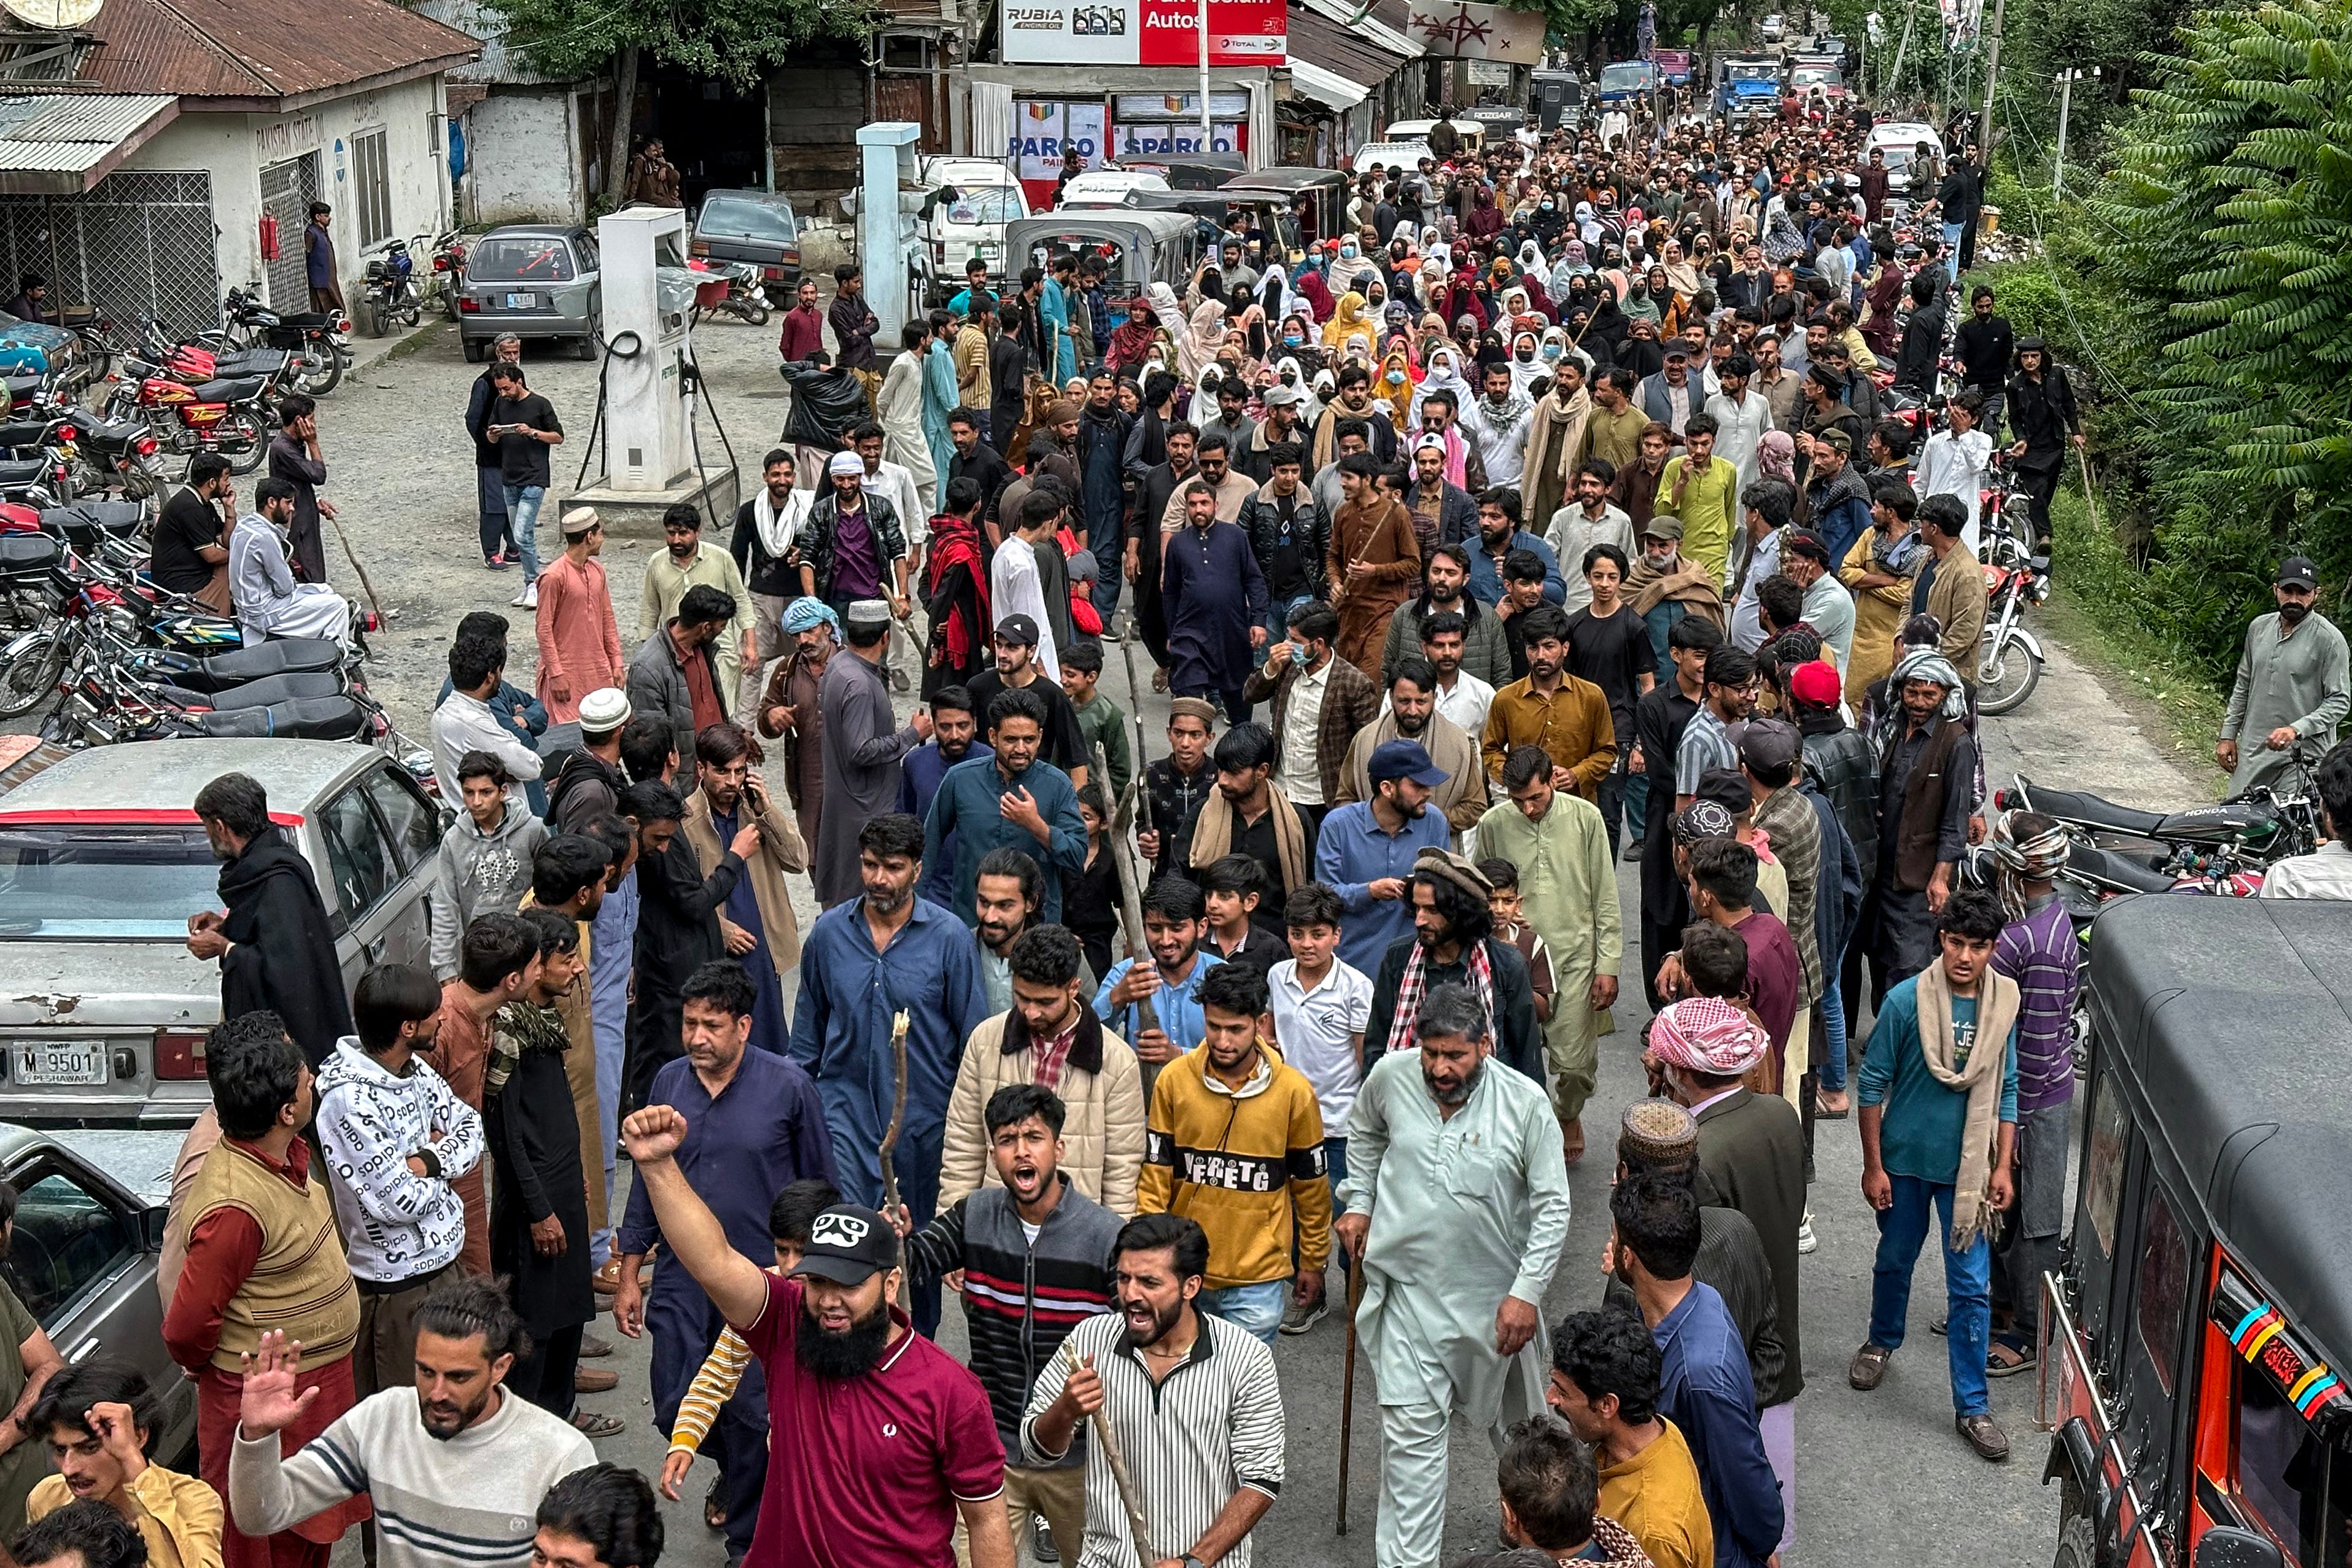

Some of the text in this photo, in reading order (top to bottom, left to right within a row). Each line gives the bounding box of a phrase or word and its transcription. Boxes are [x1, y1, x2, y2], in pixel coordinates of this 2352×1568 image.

[256, 113, 327, 163] PAKISTAN STATE OIL
[1042, 158, 1089, 169] PAIS
[2185, 808, 2228, 817] HONDA
[48, 1053, 91, 1072] 9501
